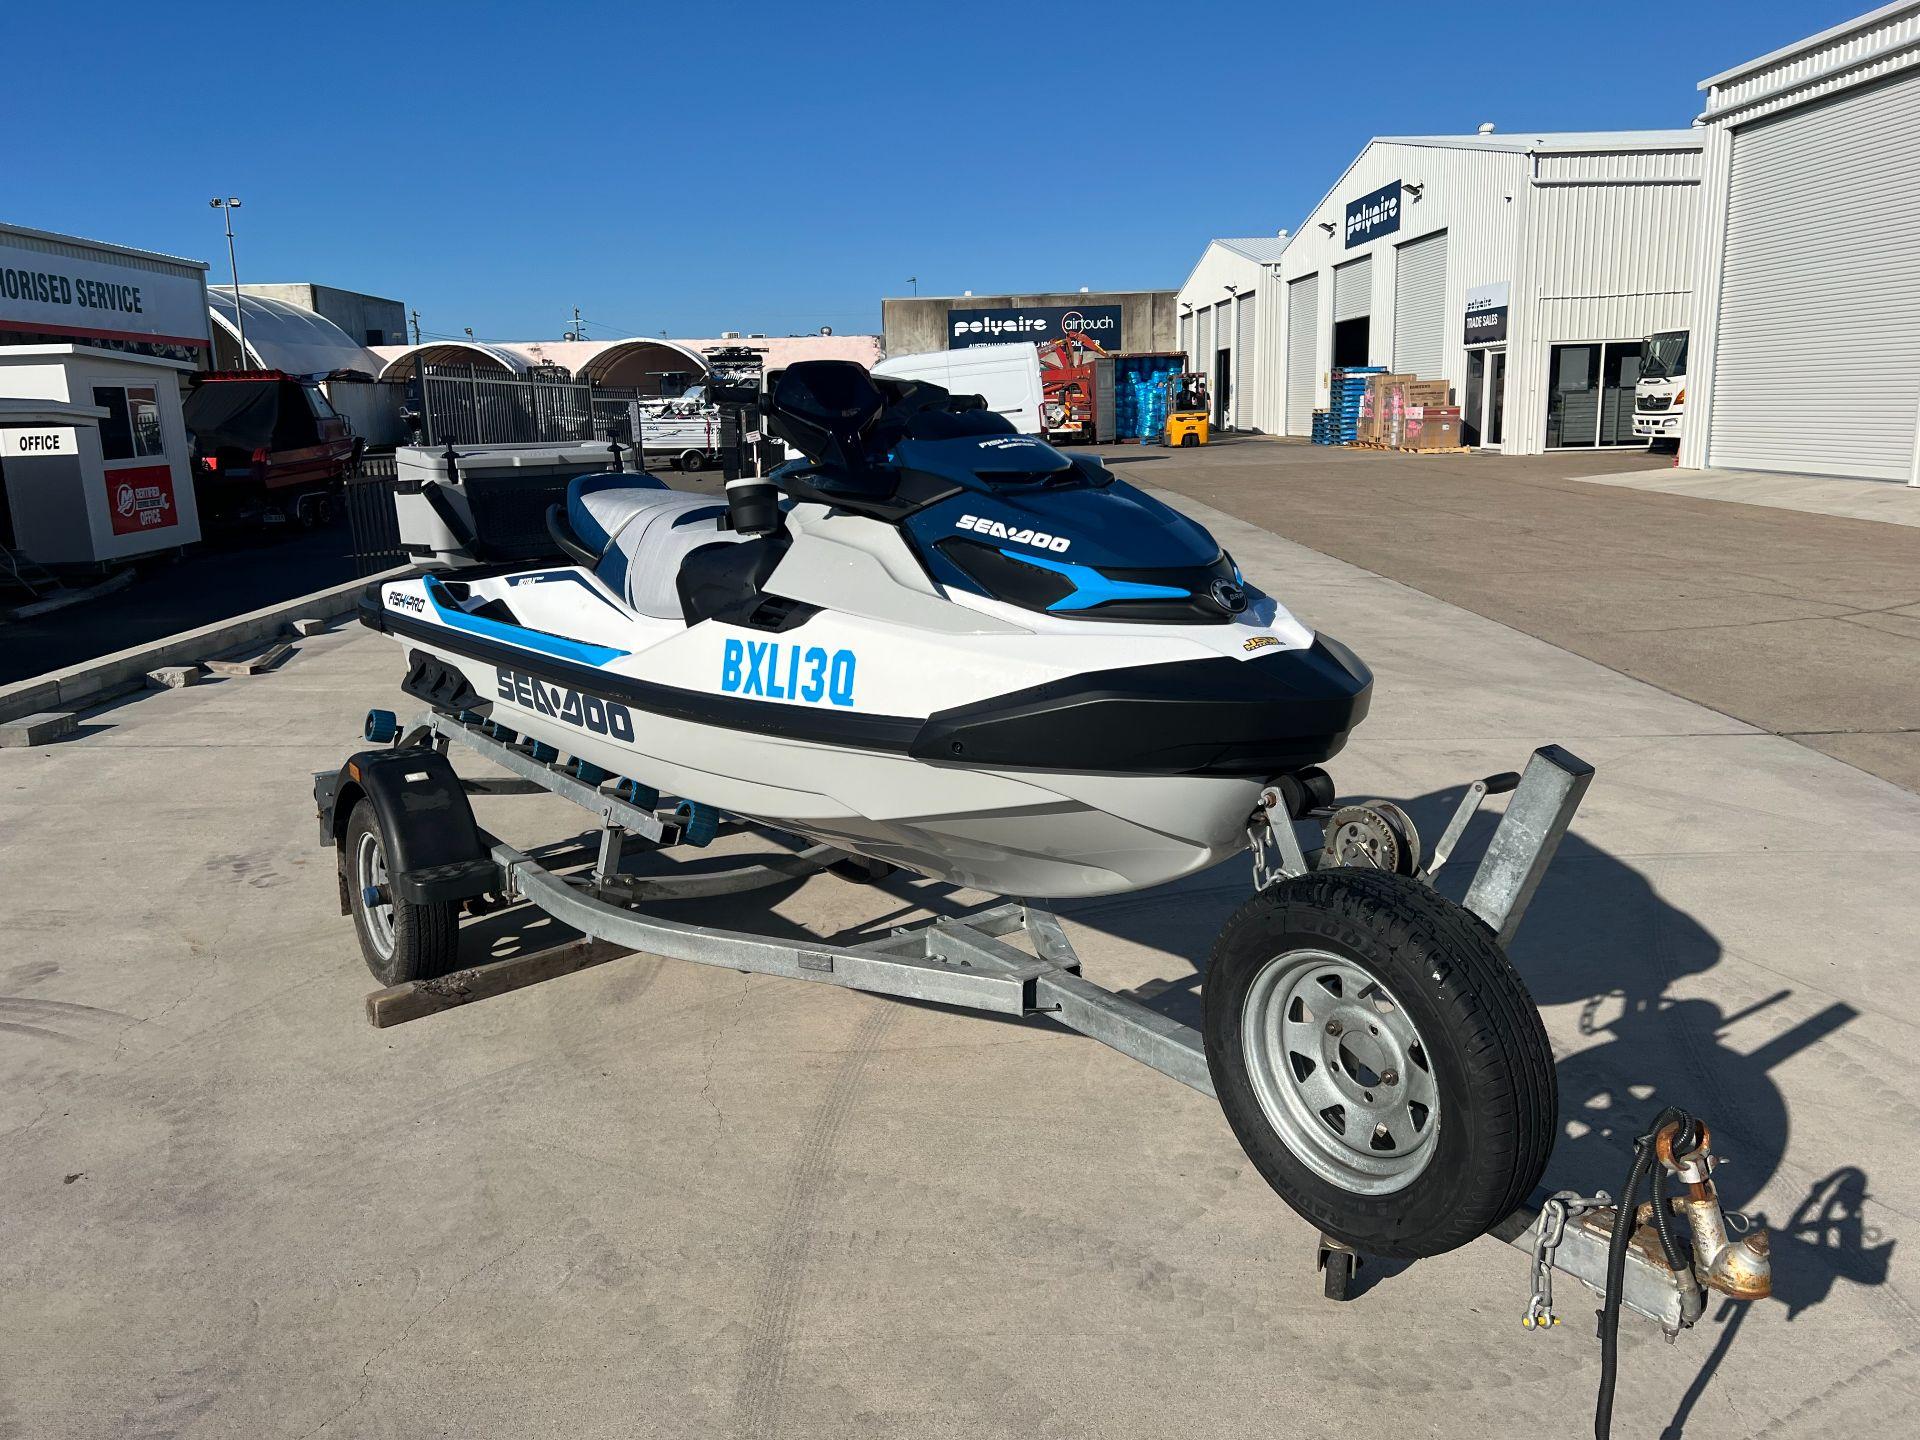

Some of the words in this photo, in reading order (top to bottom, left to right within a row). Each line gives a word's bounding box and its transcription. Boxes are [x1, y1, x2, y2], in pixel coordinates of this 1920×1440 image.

[1347, 195, 1398, 241] polyaire
[75, 278, 143, 314] SERVICE
[955, 316, 1047, 337] polyaire
[1064, 315, 1115, 332] airtouch
[1467, 316, 1482, 328] TRADE
[1483, 313, 1498, 327] SALES
[20, 435, 60, 451] OFFICE
